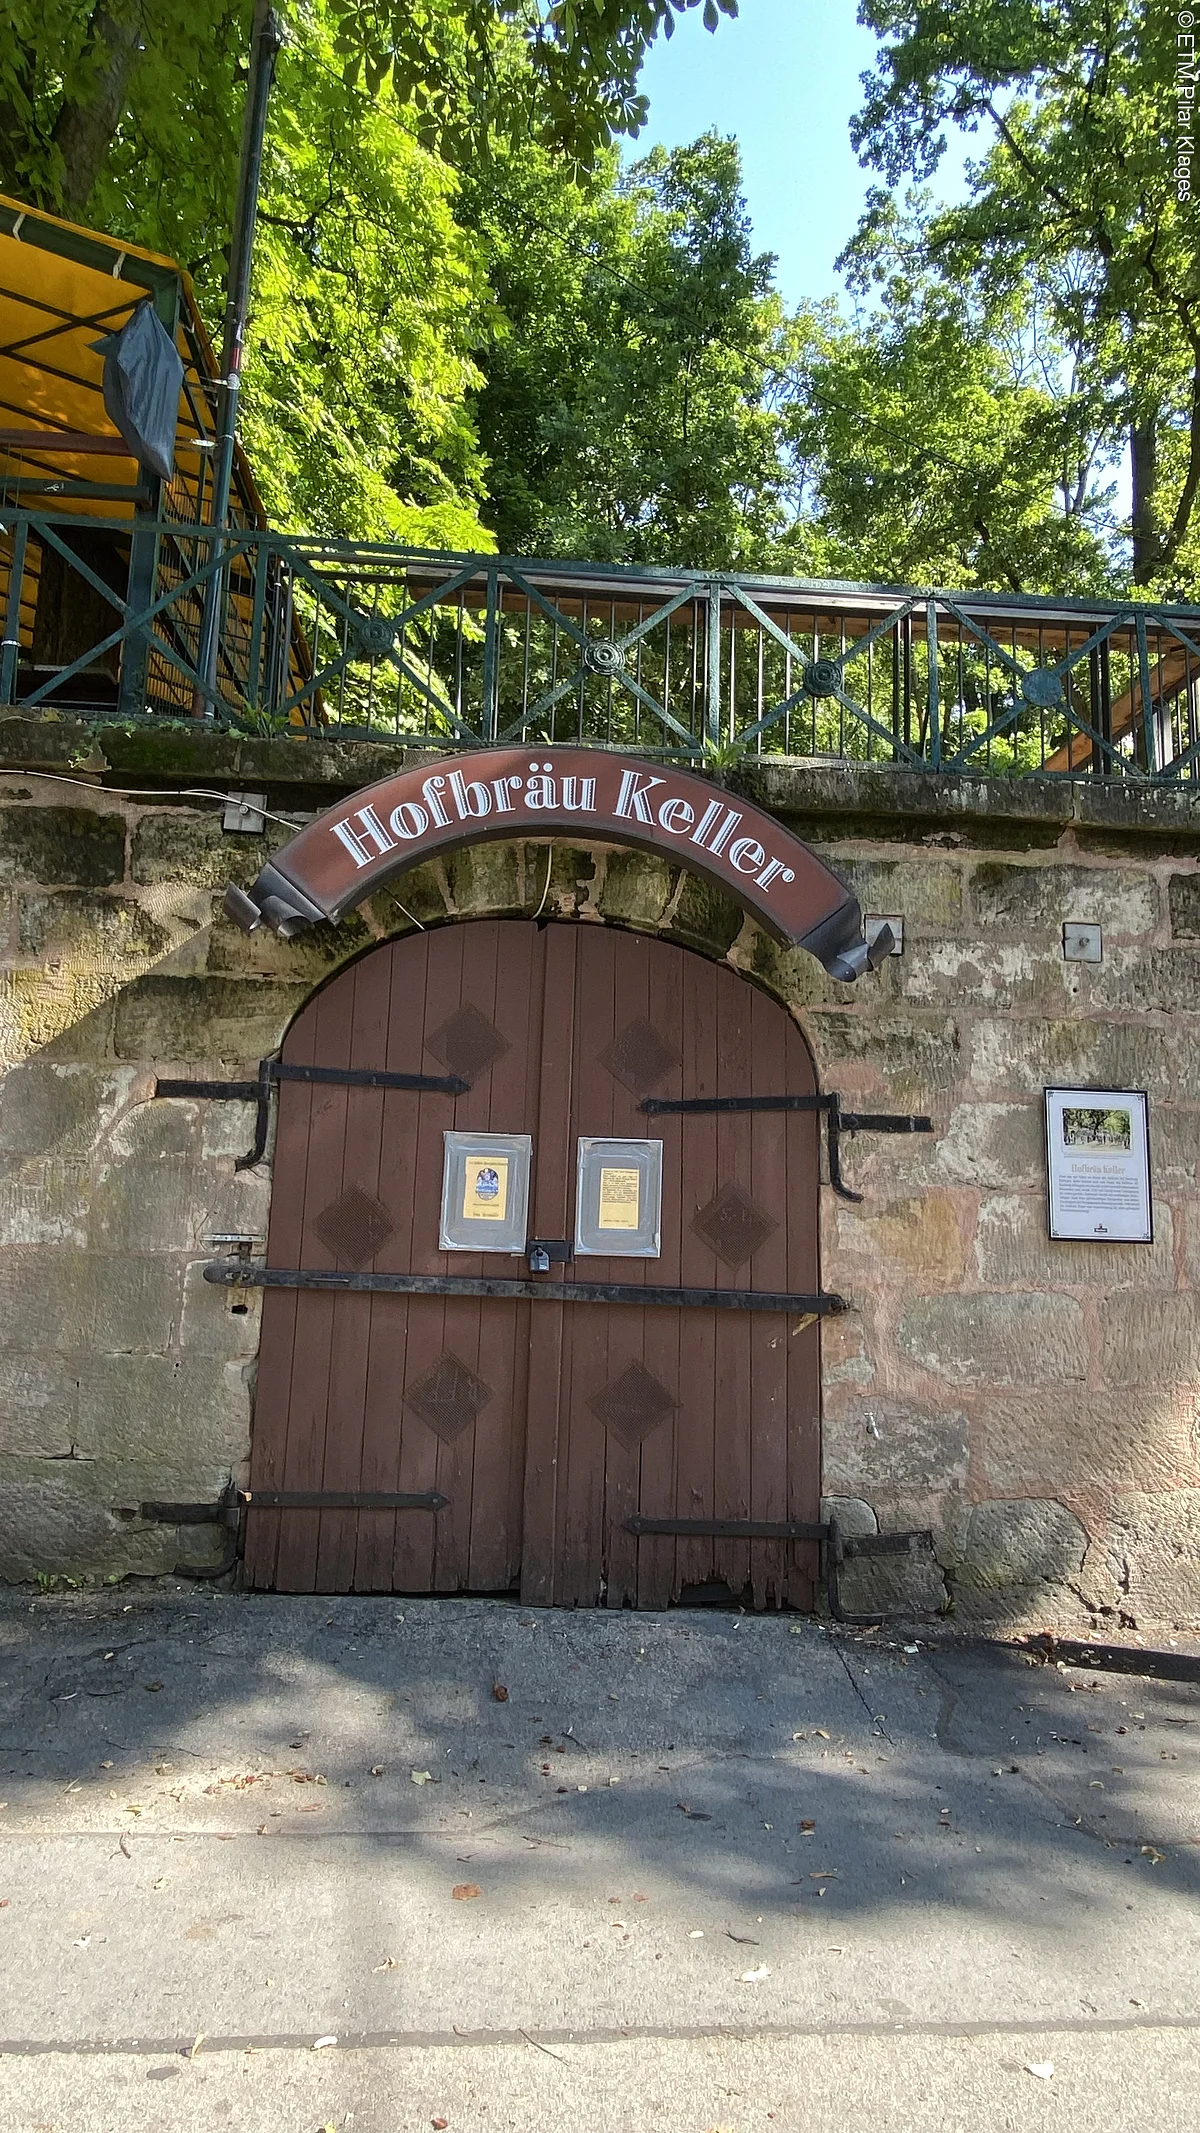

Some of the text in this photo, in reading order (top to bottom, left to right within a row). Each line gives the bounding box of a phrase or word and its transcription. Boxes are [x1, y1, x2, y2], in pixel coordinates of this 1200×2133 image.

[329, 762, 796, 893] Hofbräu Keller
[1103, 1164, 1126, 1175] Keller
